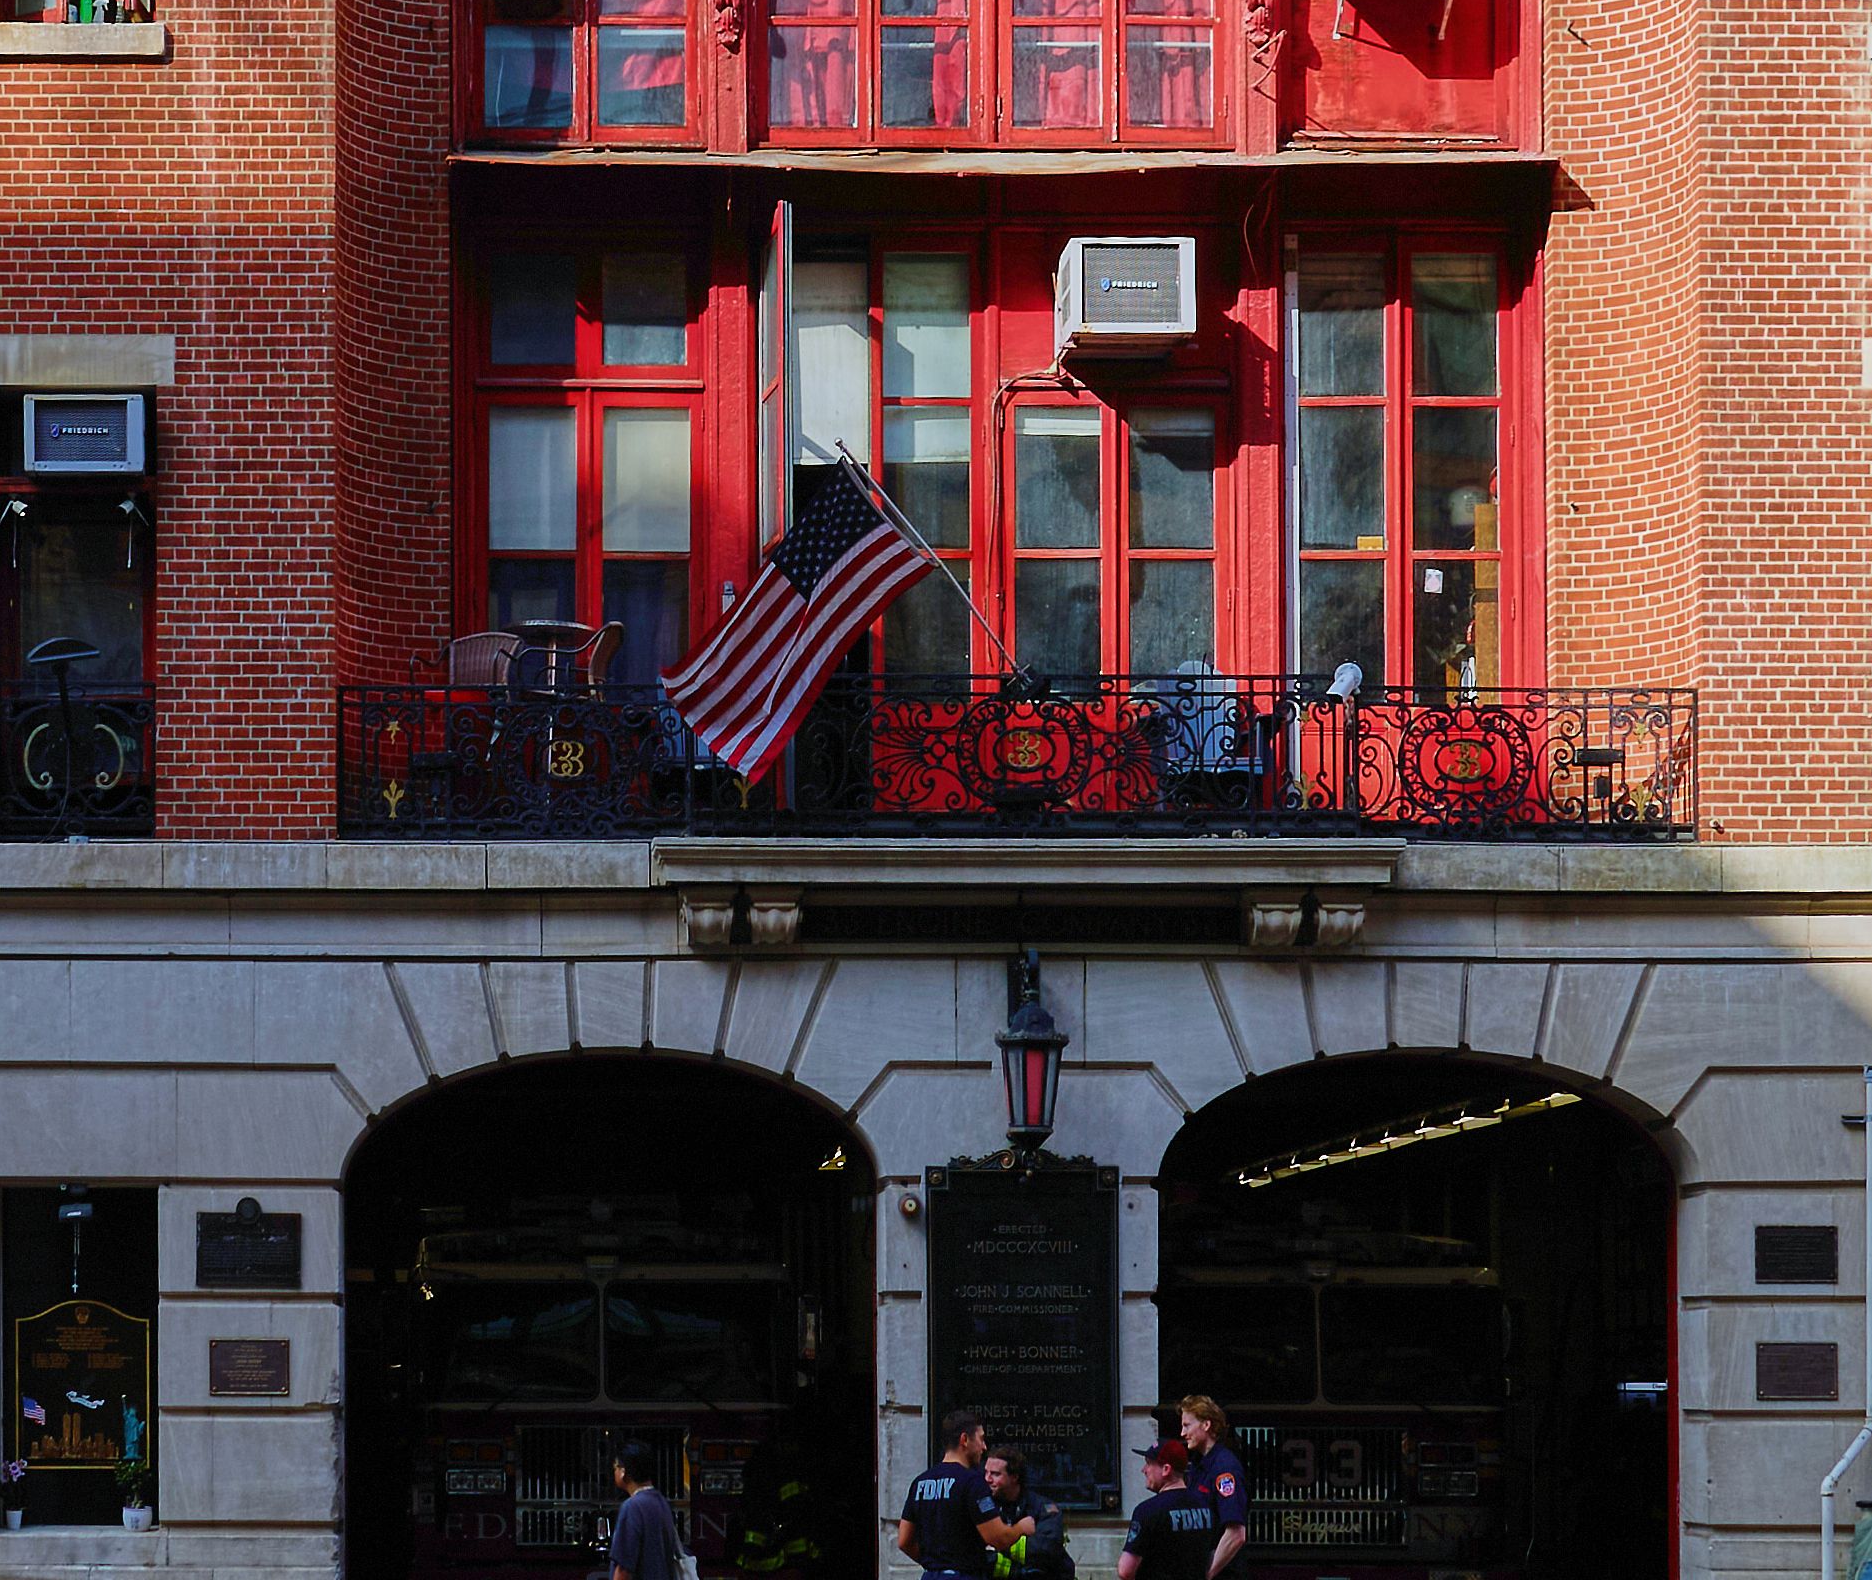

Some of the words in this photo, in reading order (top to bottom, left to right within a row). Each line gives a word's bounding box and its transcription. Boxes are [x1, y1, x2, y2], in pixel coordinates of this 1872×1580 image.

[61, 426, 109, 434] FRIEDRICH
[998, 1225, 1048, 1234] ERECTED
[973, 1241, 1073, 1254] MDCCCXCVIII
[960, 1285, 997, 1299] JOHN
[1017, 1285, 1088, 1298] SCANNELL
[998, 1305, 1074, 1314] COMMISSIONER
[1019, 1345, 1078, 1359] BONNER
[1017, 1364, 1083, 1373] DEPARTMENT
[1004, 1424, 1085, 1437] CHAMBERS
[1282, 1438, 1363, 1488] 33
[914, 1476, 957, 1501] FDNY
[1168, 1507, 1213, 1533] FDNY
